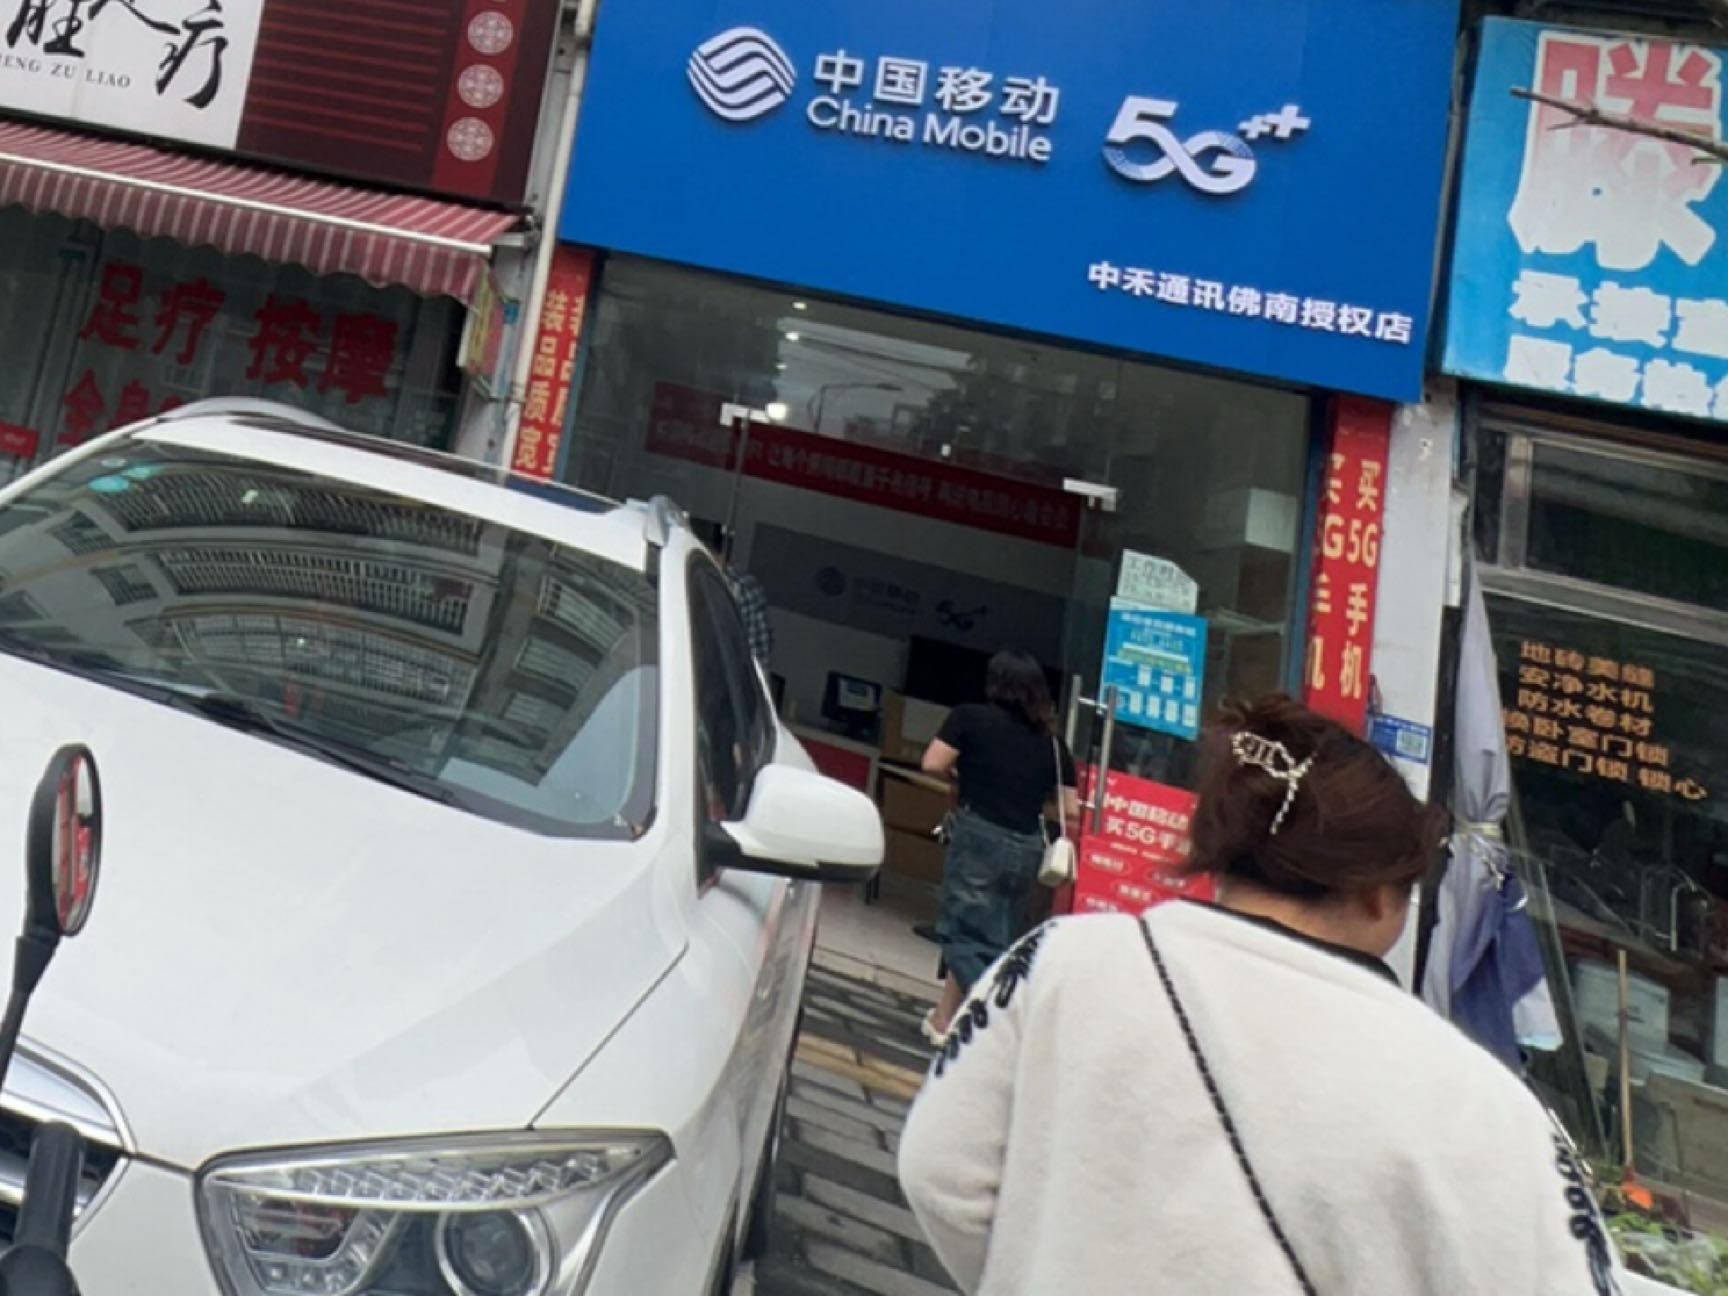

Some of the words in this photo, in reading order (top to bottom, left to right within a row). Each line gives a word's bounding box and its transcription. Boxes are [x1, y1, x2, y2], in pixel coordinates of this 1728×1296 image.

[50, 62, 75, 81] ZU
[85, 68, 131, 89] LIAO
[813, 49, 1060, 124] 中国移动
[806, 95, 912, 141] China
[922, 114, 1053, 162] Mobile
[80, 261, 225, 365] 足疗
[244, 292, 399, 405] 按摩
[1087, 260, 1414, 345] 中禾通讯佛南授权店
